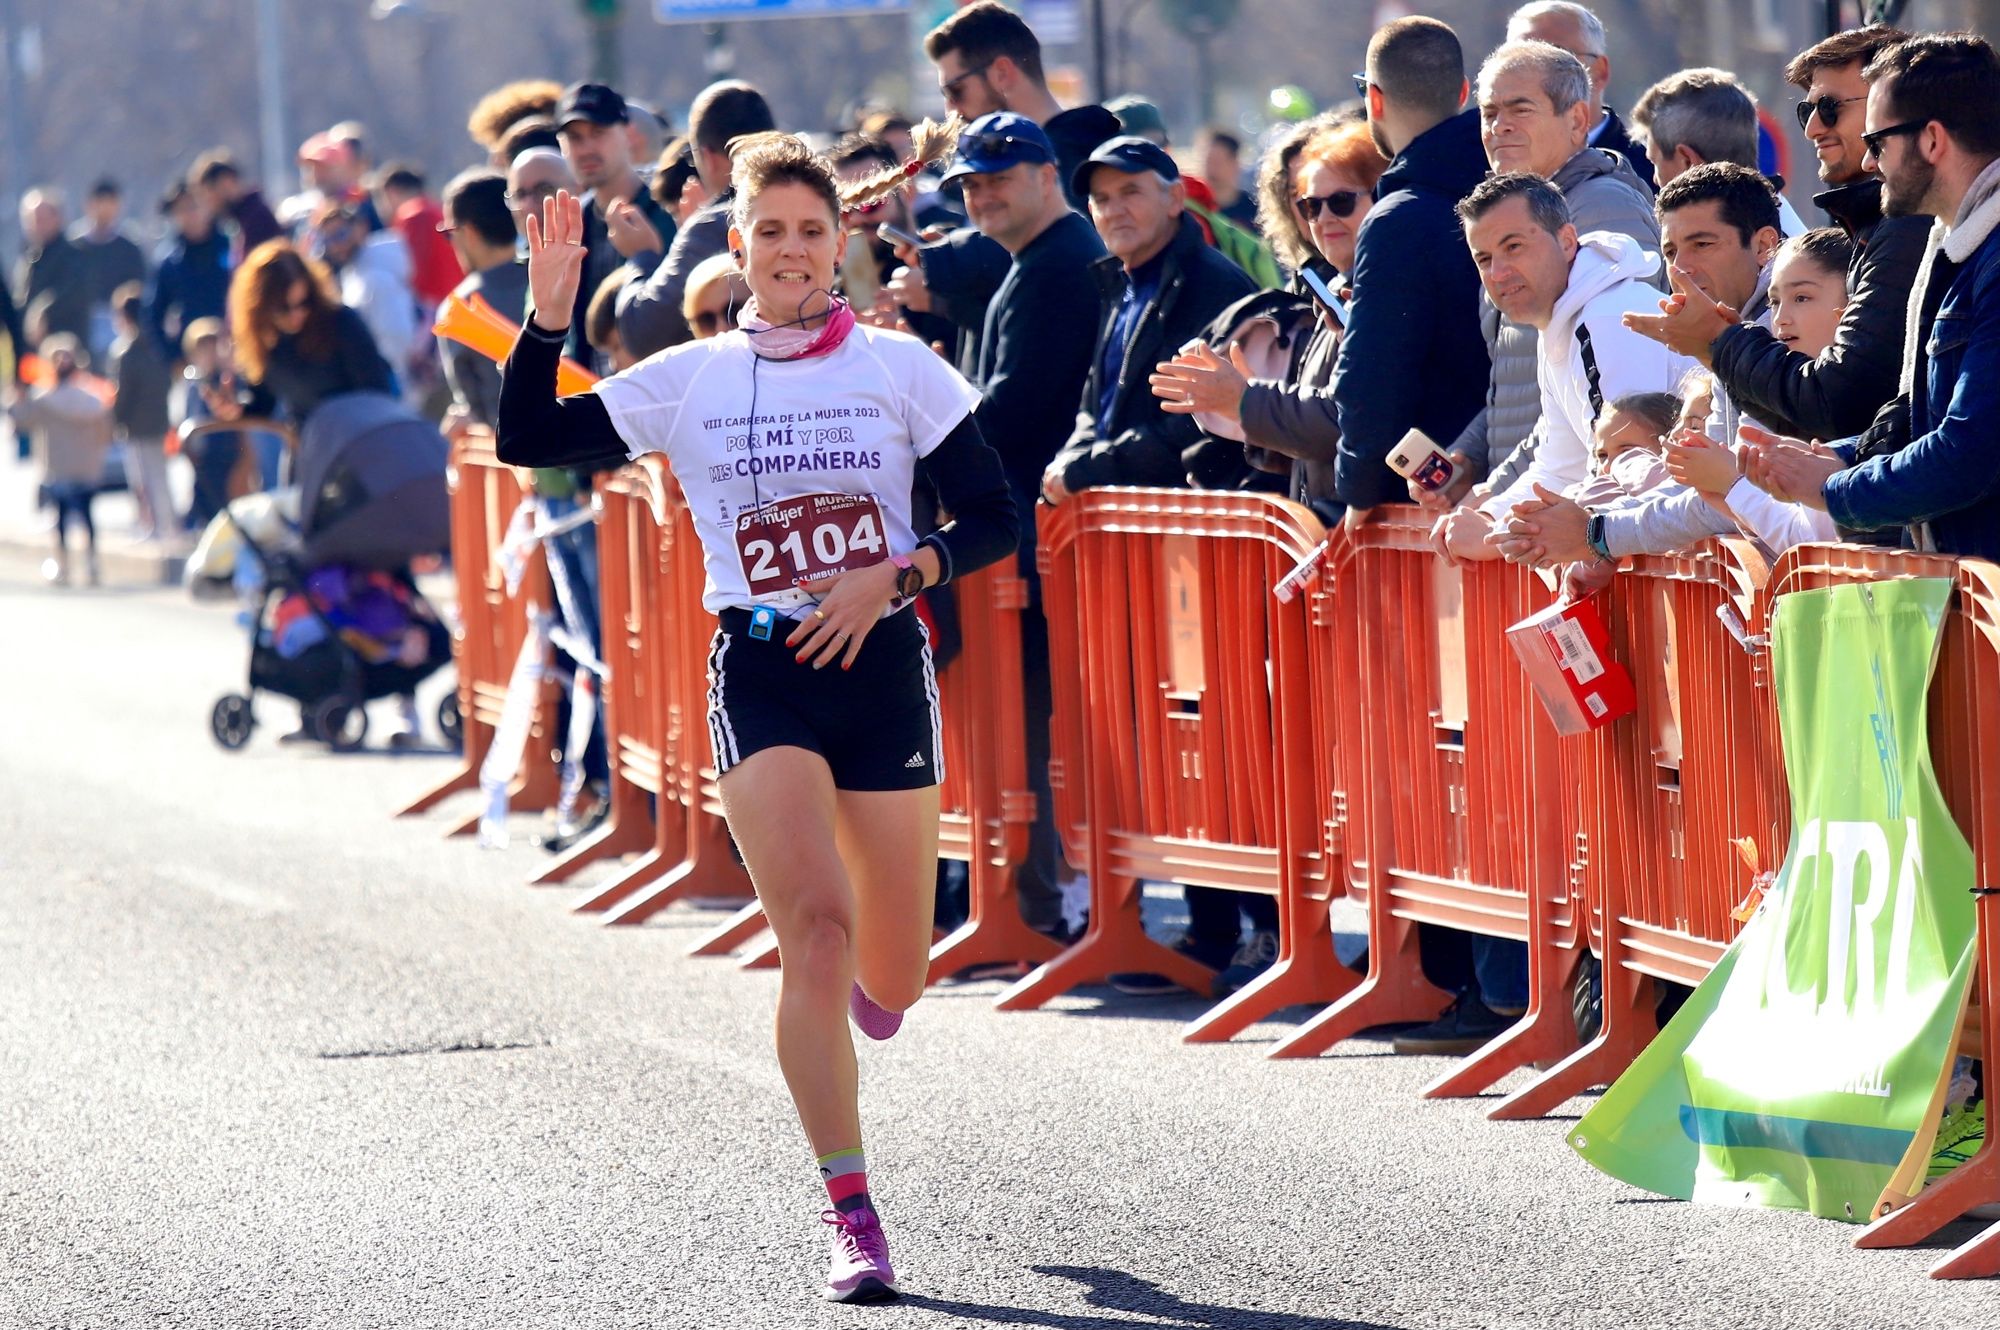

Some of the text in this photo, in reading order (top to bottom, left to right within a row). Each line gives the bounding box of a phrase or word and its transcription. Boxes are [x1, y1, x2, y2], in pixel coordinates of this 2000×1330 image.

[703, 407, 880, 430] VIII CARRERA DE LA MUJER 2023
[726, 424, 855, 451] POR MÍ Y POR
[708, 447, 881, 483] MIS COMPAÑERAS
[813, 495, 869, 508] MURCIA
[821, 505, 830, 513] DE
[831, 502, 855, 511] MARZO
[761, 505, 804, 529] mujer
[744, 514, 883, 582] 2104
